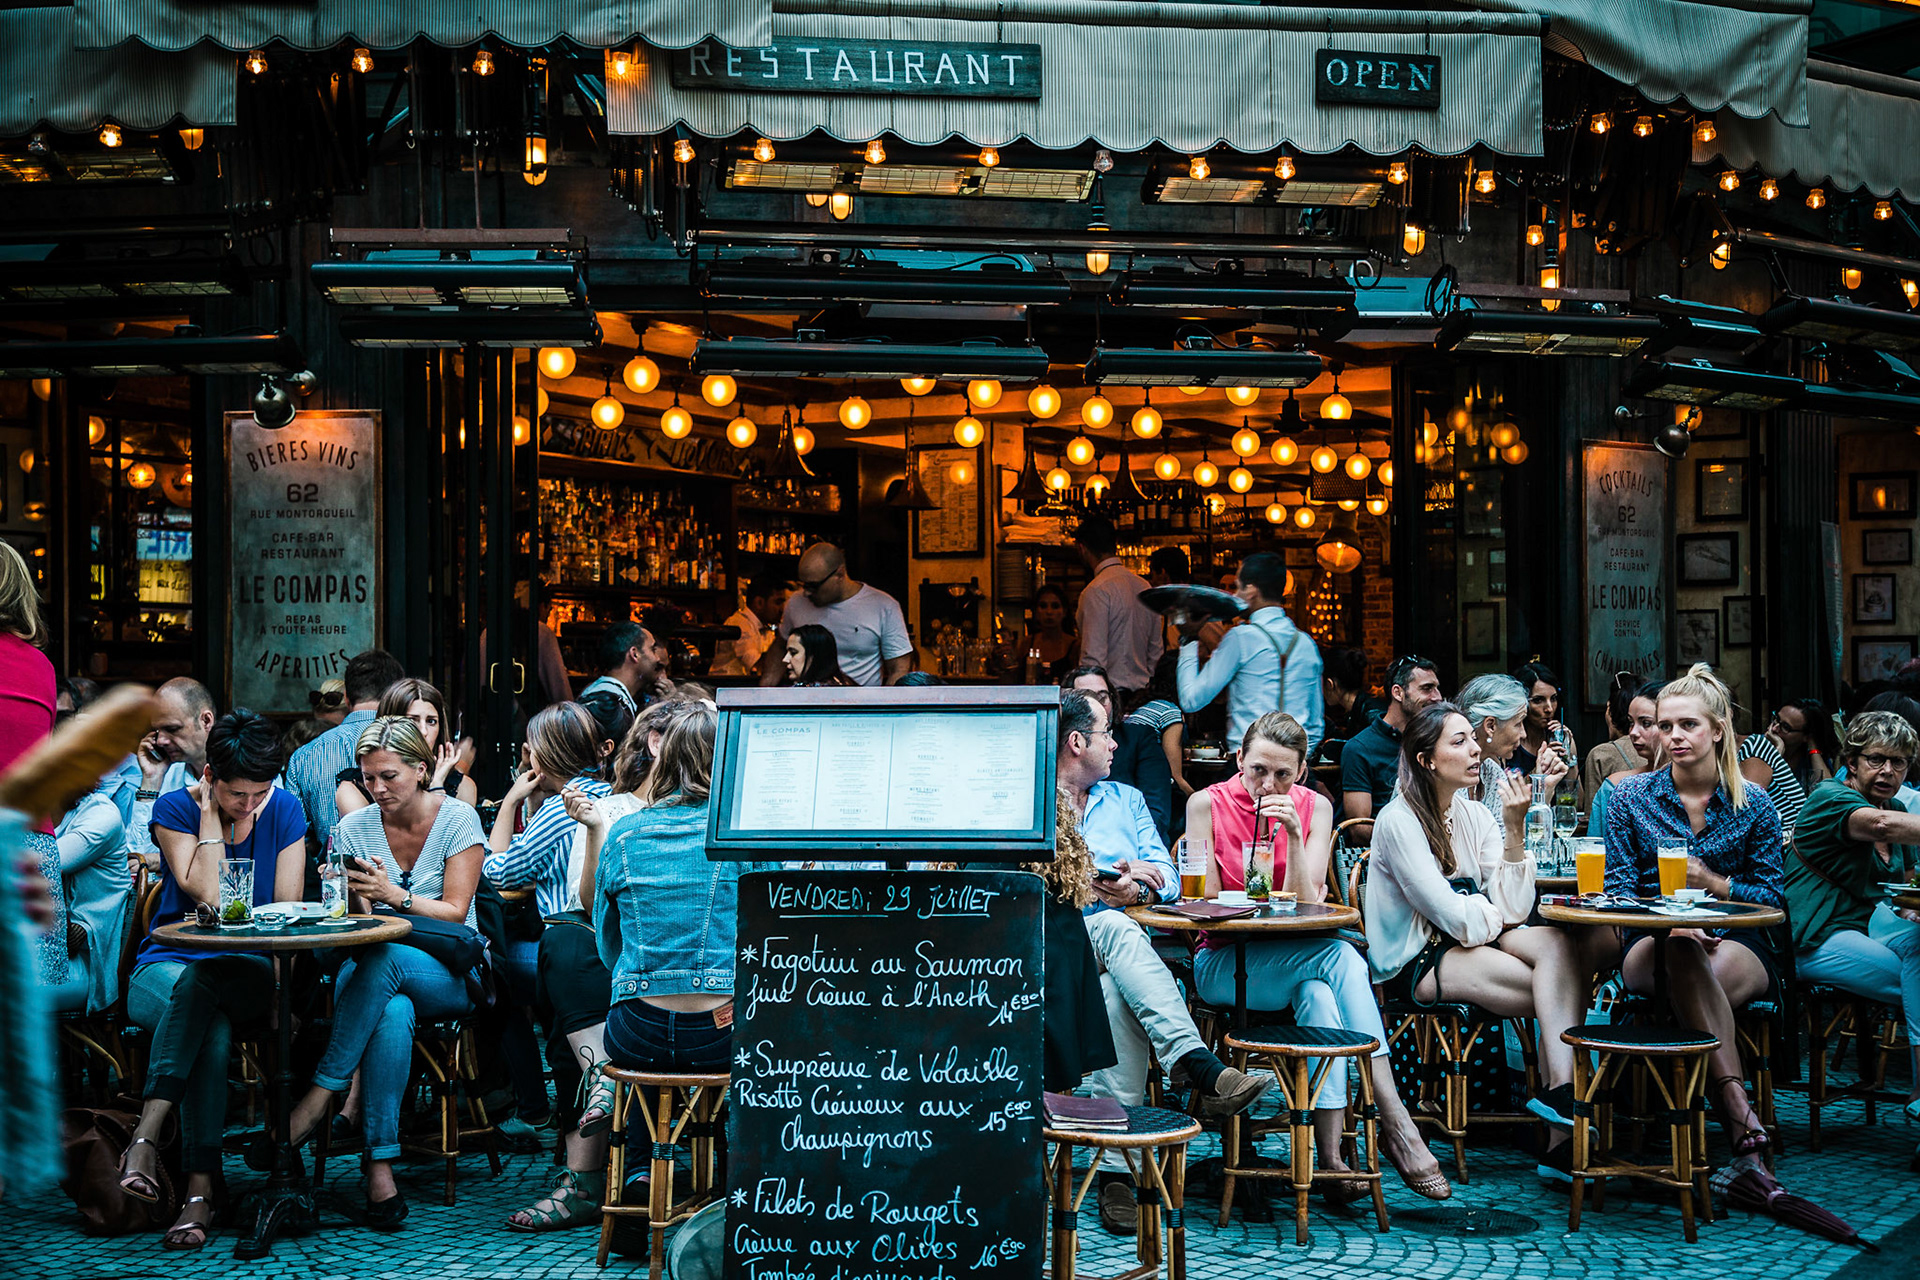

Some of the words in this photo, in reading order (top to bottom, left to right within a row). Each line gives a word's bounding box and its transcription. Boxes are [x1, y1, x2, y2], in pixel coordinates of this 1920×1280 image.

[690, 43, 1023, 86] RESTAURANT
[1326, 59, 1434, 91] OPEN
[247, 440, 308, 472] BIERES
[319, 441, 358, 471] VINS
[286, 483, 319, 503] 62
[1599, 470, 1653, 497] COCKTAILS
[250, 509, 271, 519] RUE
[276, 509, 355, 519] MONTORGUEIL
[1618, 506, 1636, 523] 62
[261, 548, 345, 559] RESTAURANT
[1604, 561, 1650, 572] RESTAURANT
[239, 575, 265, 603] LE
[274, 575, 367, 603] COMPAS
[1592, 584, 1606, 609] LE
[1611, 584, 1661, 611] COMPAS
[271, 625, 306, 635] TOUTE
[311, 625, 347, 635] HEURE
[285, 615, 321, 624] REPAS
[1614, 619, 1640, 628] SERVICE
[255, 649, 350, 678] APERITIFS
[1595, 649, 1660, 675] CHAMPAGNES
[884, 885, 911, 911] 29
[871, 959, 905, 975] au
[915, 940, 1023, 977] Saumon
[807, 978, 872, 1007] Crème
[881, 985, 899, 1007] à
[755, 1040, 872, 1088] Suprême
[880, 1050, 911, 1081] de
[735, 1078, 803, 1108] Risotto
[919, 1100, 974, 1119] aux
[781, 1114, 933, 1168] Champignons
[754, 1178, 815, 1216] Filets
[826, 1186, 854, 1220] de
[861, 1186, 979, 1245] Rougets
[734, 1223, 797, 1255] Crème
[810, 1240, 860, 1259] aux
[873, 1232, 957, 1263] Olives
